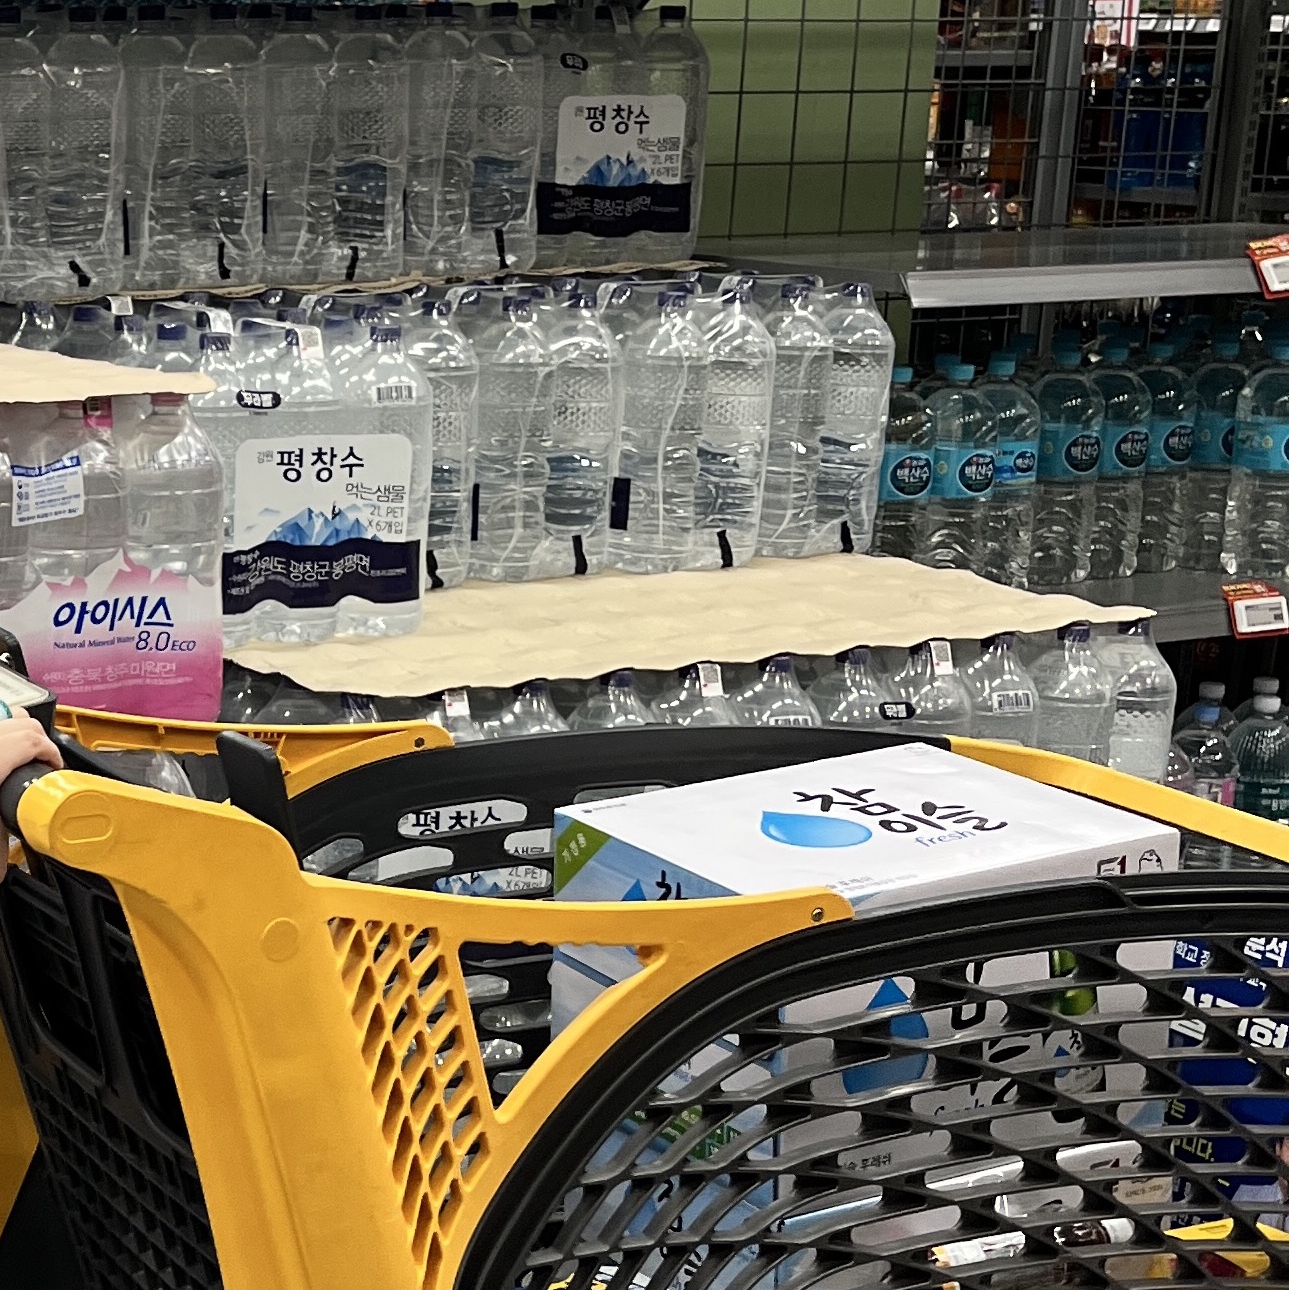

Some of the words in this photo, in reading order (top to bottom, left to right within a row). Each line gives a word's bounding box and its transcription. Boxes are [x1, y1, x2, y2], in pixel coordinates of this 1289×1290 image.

[585, 105, 650, 134] 평창수
[276, 446, 365, 483] 평창수
[897, 467, 930, 483] 백산수
[965, 464, 994, 480] 백산수
[345, 482, 407, 503] 먹는샘물
[369, 506, 383, 516] 2L
[386, 506, 405, 518] PET
[289, 561, 330, 582] 평창군
[332, 553, 371, 576] 봉평면
[53, 595, 174, 634] 아이시스
[135, 630, 171, 652] 8.0
[171, 640, 197, 652] ECO
[914, 829, 977, 848] fresh
